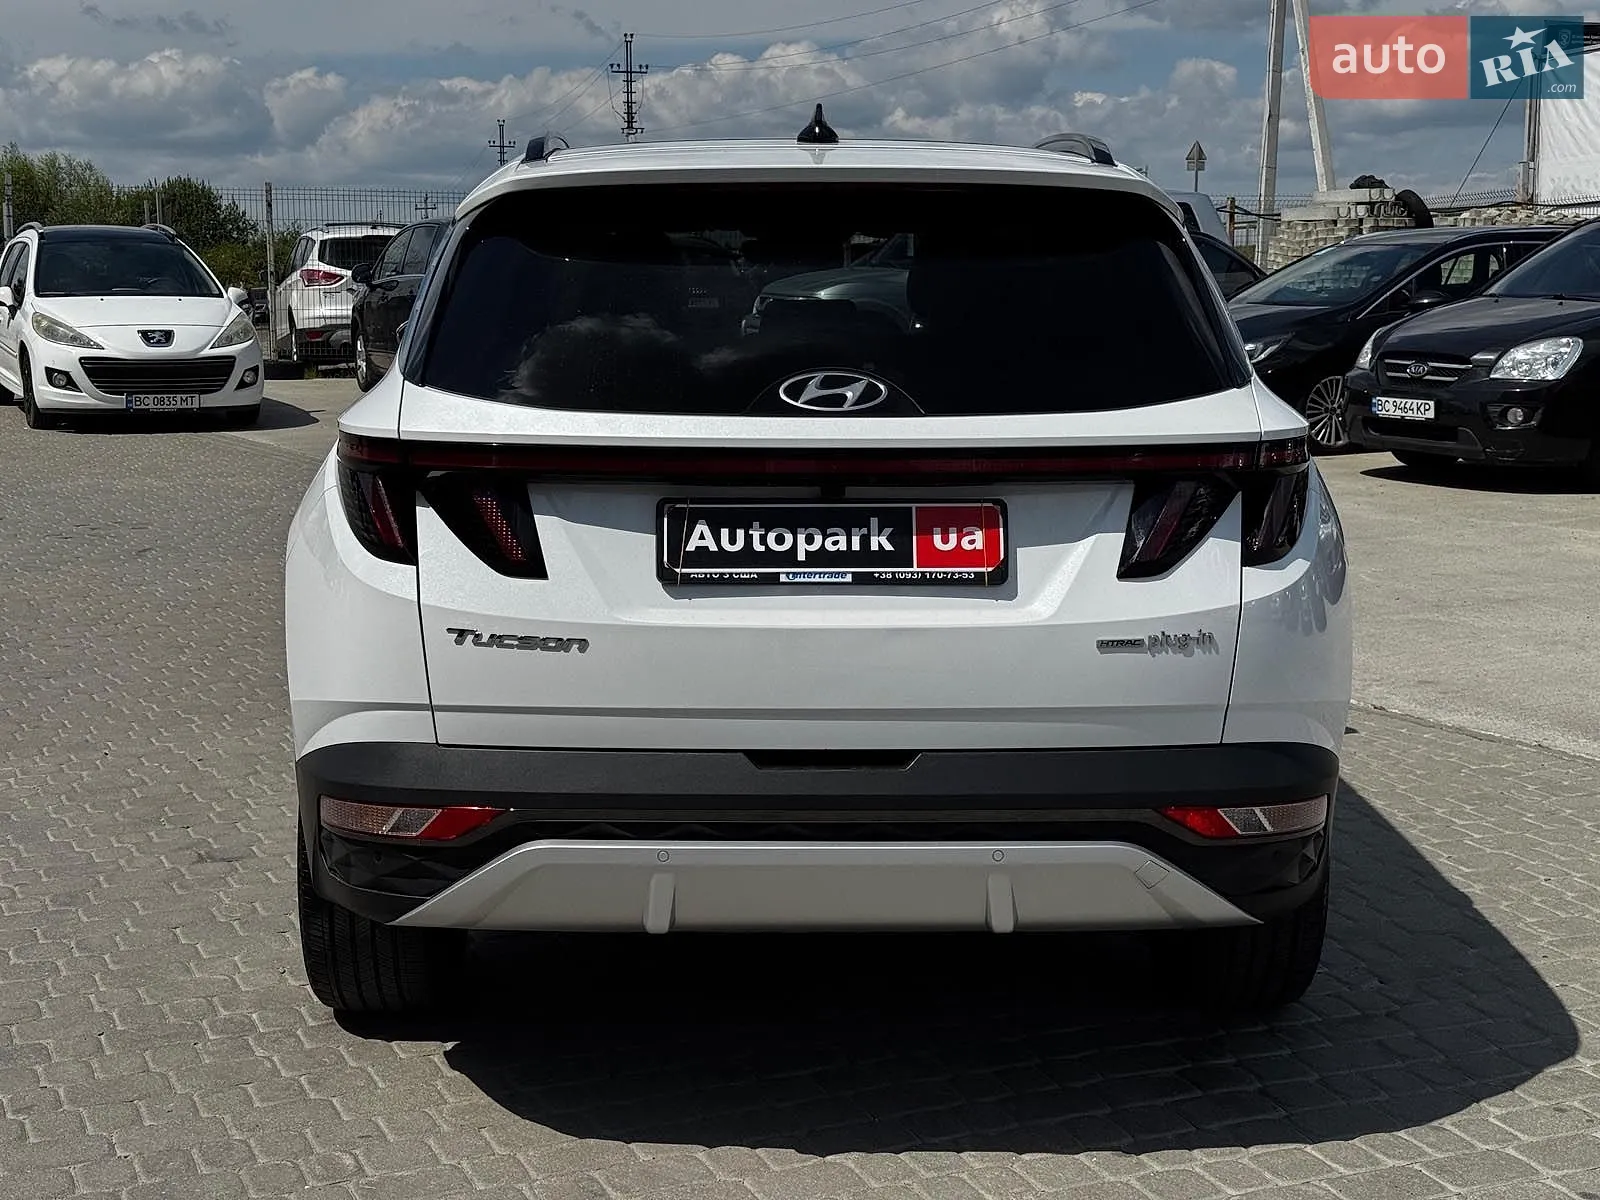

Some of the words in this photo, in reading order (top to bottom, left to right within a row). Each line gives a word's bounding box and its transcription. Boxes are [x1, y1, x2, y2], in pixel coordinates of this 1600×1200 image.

[134, 396, 150, 407] BC
[152, 396, 178, 407] 0835
[180, 396, 196, 406] MT
[1377, 399, 1390, 413] BC
[1392, 400, 1415, 414] 9464
[1416, 402, 1431, 416] KP
[685, 517, 895, 561] Autopark
[932, 525, 984, 551] ua
[1099, 639, 1141, 647] HTRAC
